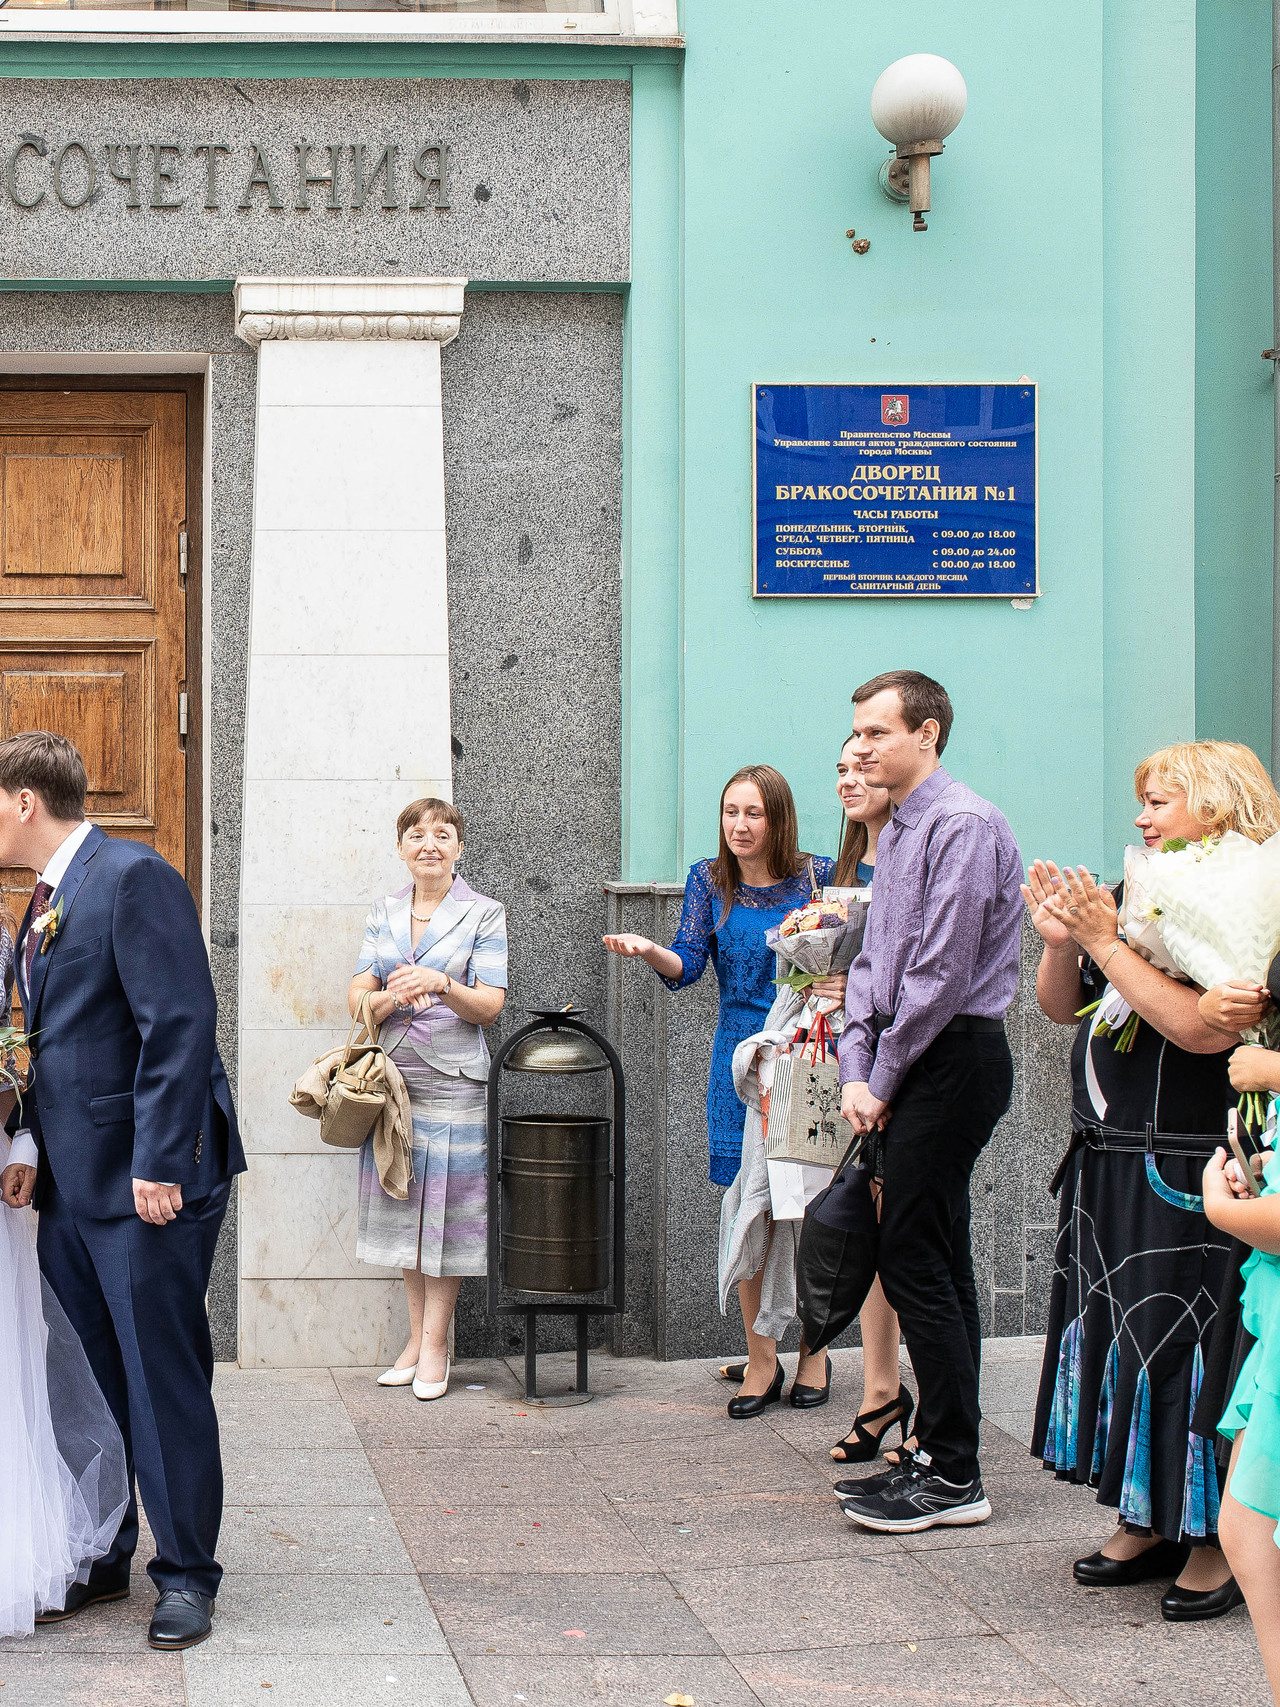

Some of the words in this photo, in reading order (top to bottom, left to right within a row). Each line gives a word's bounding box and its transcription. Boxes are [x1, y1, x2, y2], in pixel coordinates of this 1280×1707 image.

[840, 430, 911, 440] Правительство
[913, 430, 952, 440] Москвы
[773, 438, 831, 448] Управление
[832, 438, 866, 447] записи
[868, 439, 895, 447] актов
[898, 438, 966, 448] гражданского
[967, 440, 1017, 448] состояния
[859, 448, 893, 457] города
[894, 447, 933, 456] Москвы
[850, 464, 942, 484] ДВОРЕЦ
[775, 485, 978, 502] БРАКОСОЧЕТАНИЯ
[984, 485, 1016, 501] №1
[853, 509, 888, 520] ЧАСЫ
[890, 509, 939, 520] РАБОТЫ
[775, 524, 855, 534] ПОНЕДЕЛЬНИК,
[858, 524, 909, 534] ВТОРНИК,
[775, 534, 813, 544] СРЕДА,
[816, 534, 863, 544] ЧЕТВЕРГ,
[866, 534, 915, 544] ПЯТНИЦА
[941, 530, 970, 539] 09.00
[971, 530, 985, 540] до
[987, 530, 1016, 539] 18.00
[775, 547, 823, 556] СУББОТА
[941, 548, 970, 556] 09.00
[971, 548, 985, 558] до
[987, 548, 1016, 556] 24.00
[775, 559, 850, 568] ВОСКРЕСЕНЬЕ
[941, 560, 970, 569] 00.00
[971, 561, 985, 570] до
[987, 560, 1016, 569] 18.00
[823, 573, 856, 581] ПЕРВЫЙ
[858, 573, 893, 581] ВТОРНИК
[895, 573, 934, 582] КАЖДОГО
[936, 573, 969, 582] МЕСЯЦА
[850, 581, 914, 591] САНИТАРНЫЙ
[916, 582, 942, 591] ДЕНЬ
